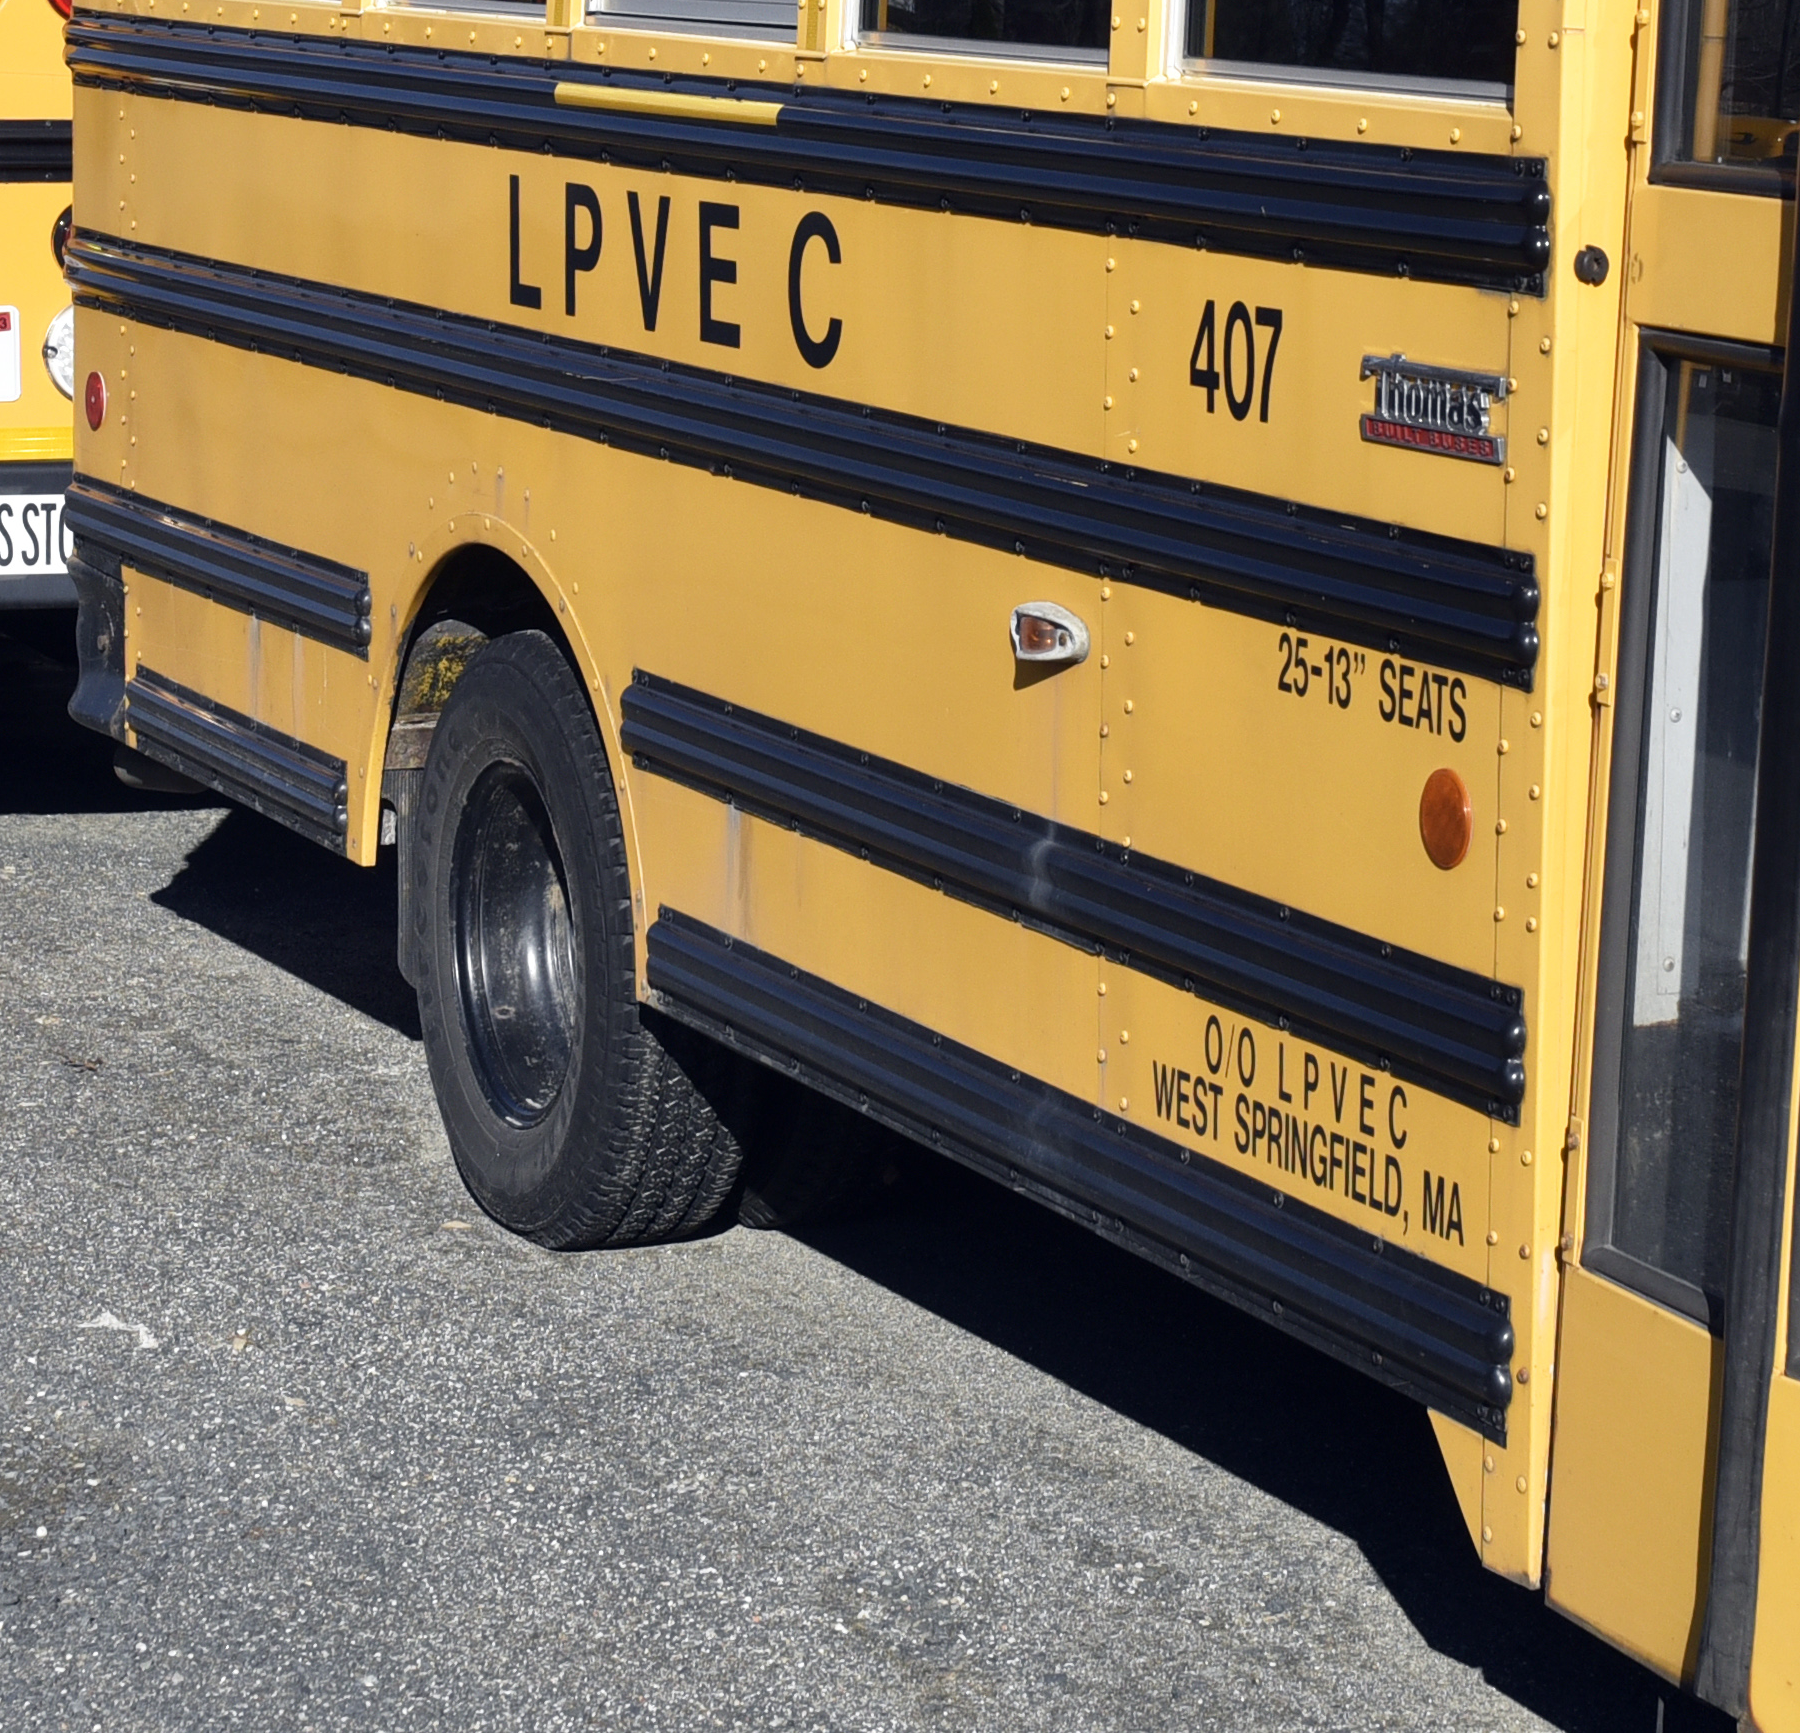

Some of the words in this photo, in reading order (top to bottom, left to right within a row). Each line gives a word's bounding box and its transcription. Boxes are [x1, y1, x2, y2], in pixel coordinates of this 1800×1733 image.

[1189, 299, 1283, 423] 407
[1360, 352, 1506, 436] Thomas
[1373, 421, 1422, 443] BUILT
[1429, 431, 1491, 456] BUSES
[1379, 659, 1467, 743] SEATS
[1153, 1060, 1224, 1141] WEST
[1235, 1093, 1409, 1235] SPRINGFIELD,
[1422, 1169, 1465, 1247] MA
